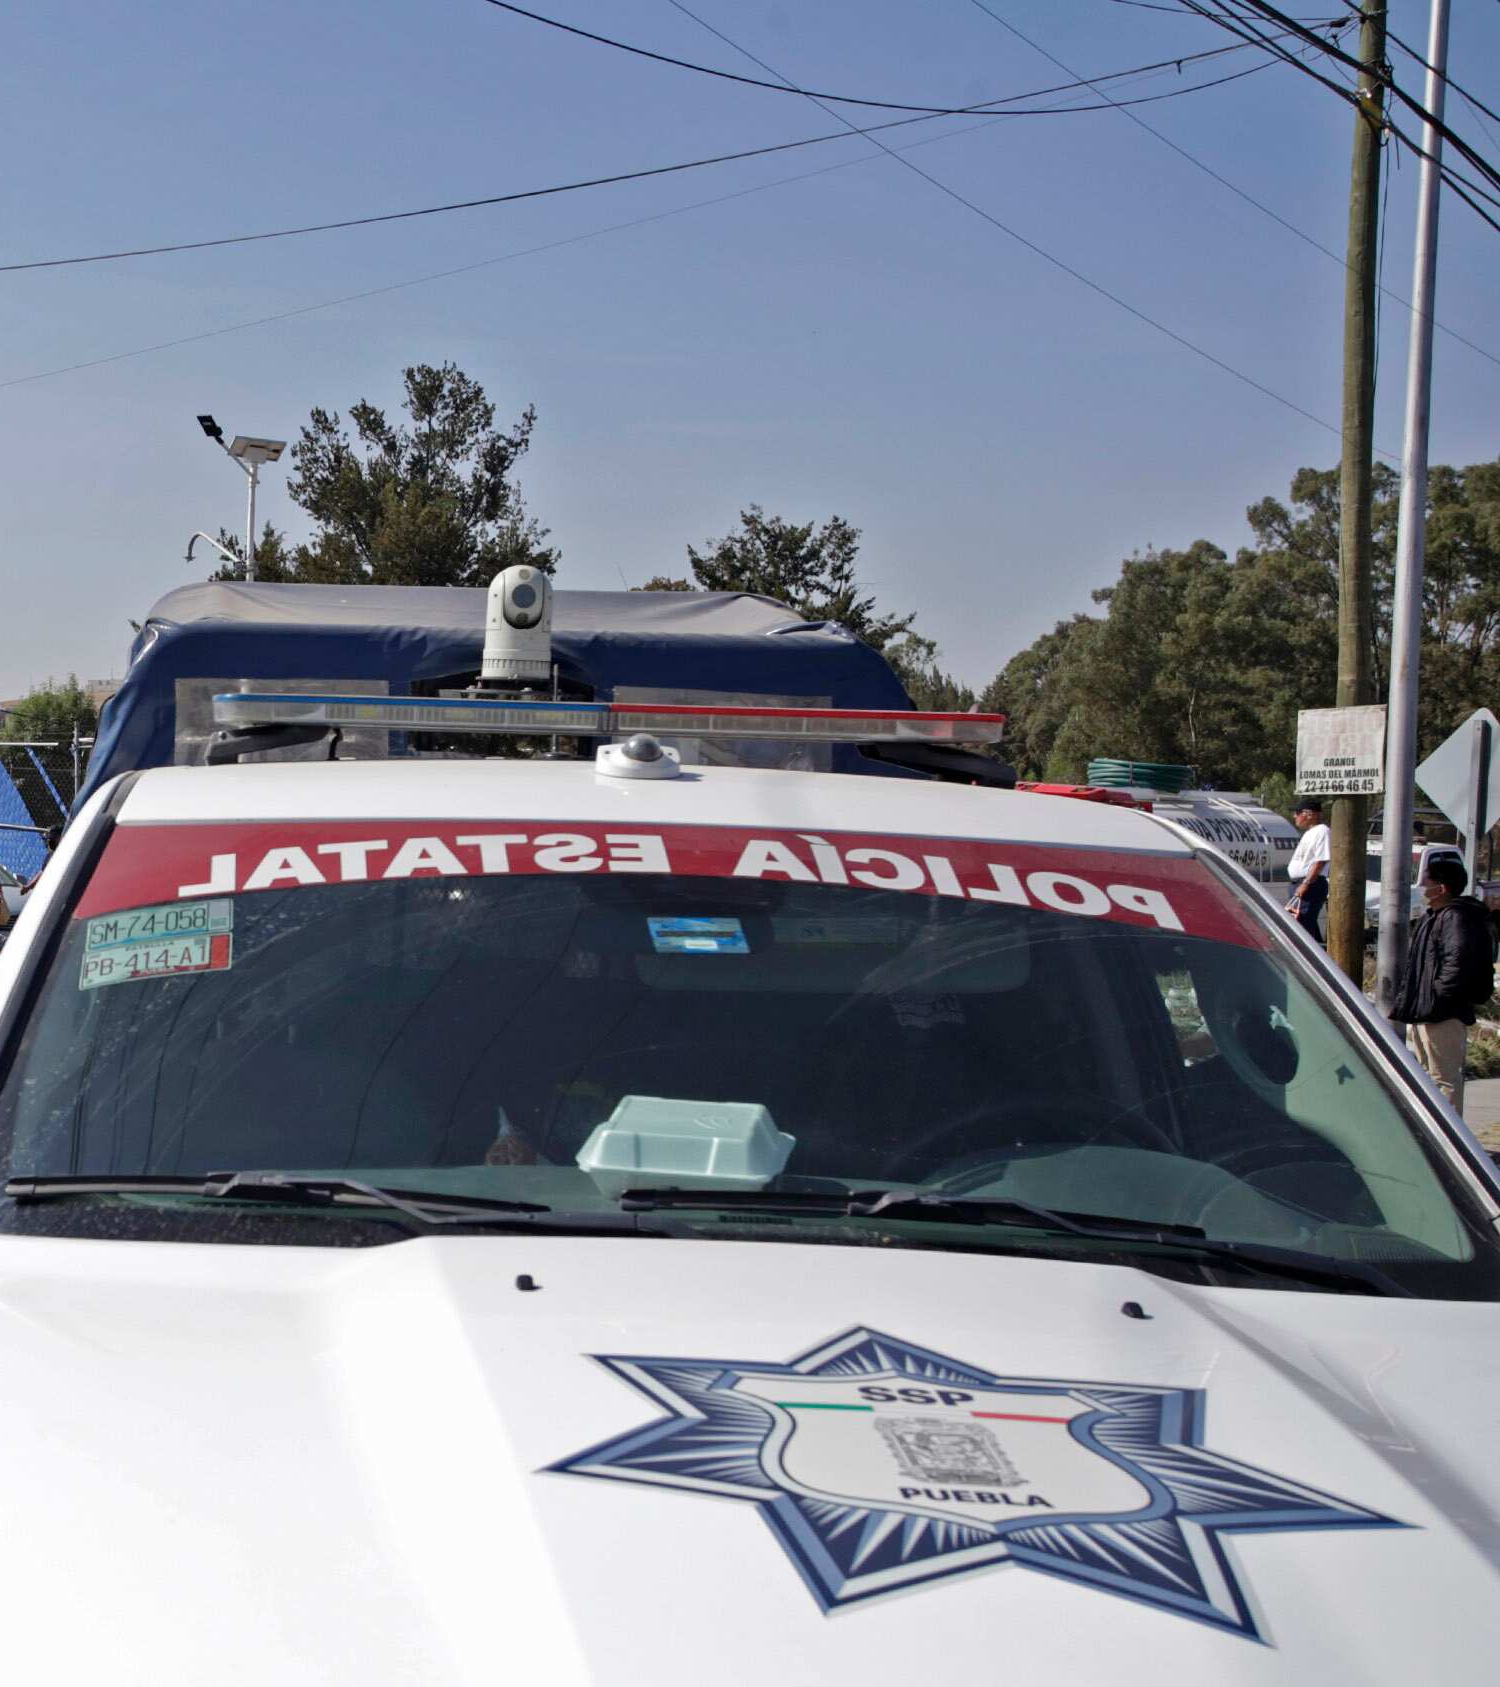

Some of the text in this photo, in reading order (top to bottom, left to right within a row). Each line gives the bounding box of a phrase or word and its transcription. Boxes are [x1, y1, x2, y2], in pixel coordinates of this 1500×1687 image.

[1323, 757, 1356, 767] GRANDE
[1300, 770, 1327, 779] LOMAS
[1328, 769, 1342, 779] DEL
[1361, 779, 1375, 792] 45
[91, 907, 206, 945] SM-74-058
[857, 1386, 974, 1406] SSP
[899, 1488, 1054, 1508] PUEBLA
